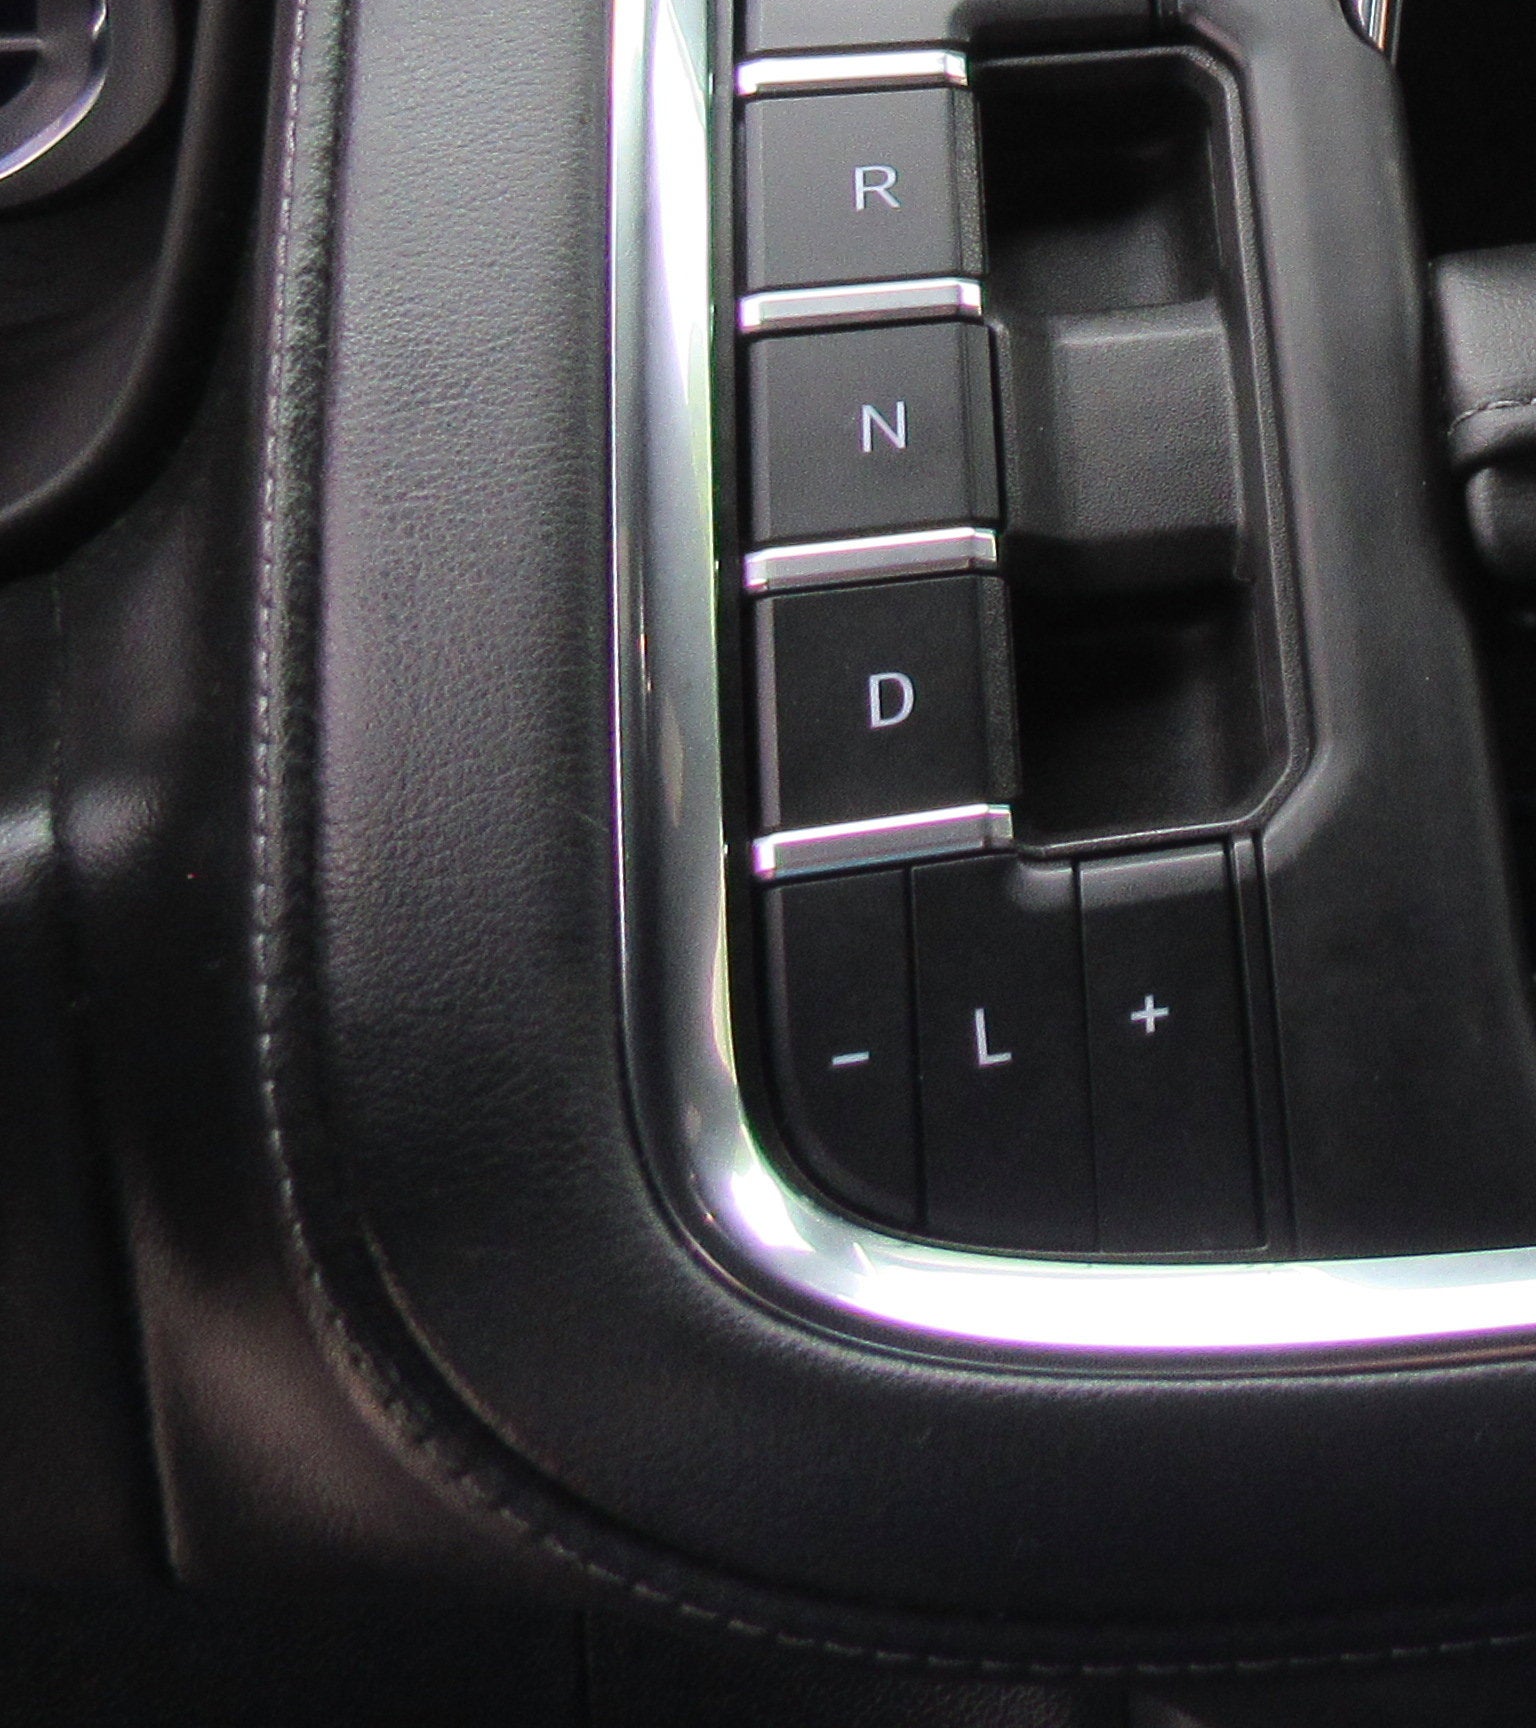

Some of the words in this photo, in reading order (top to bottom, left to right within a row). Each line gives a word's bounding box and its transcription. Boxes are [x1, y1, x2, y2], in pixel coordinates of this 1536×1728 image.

[852, 165, 901, 211] R
[858, 399, 908, 452] N
[867, 670, 915, 730] D
[972, 1007, 1013, 1068] L
